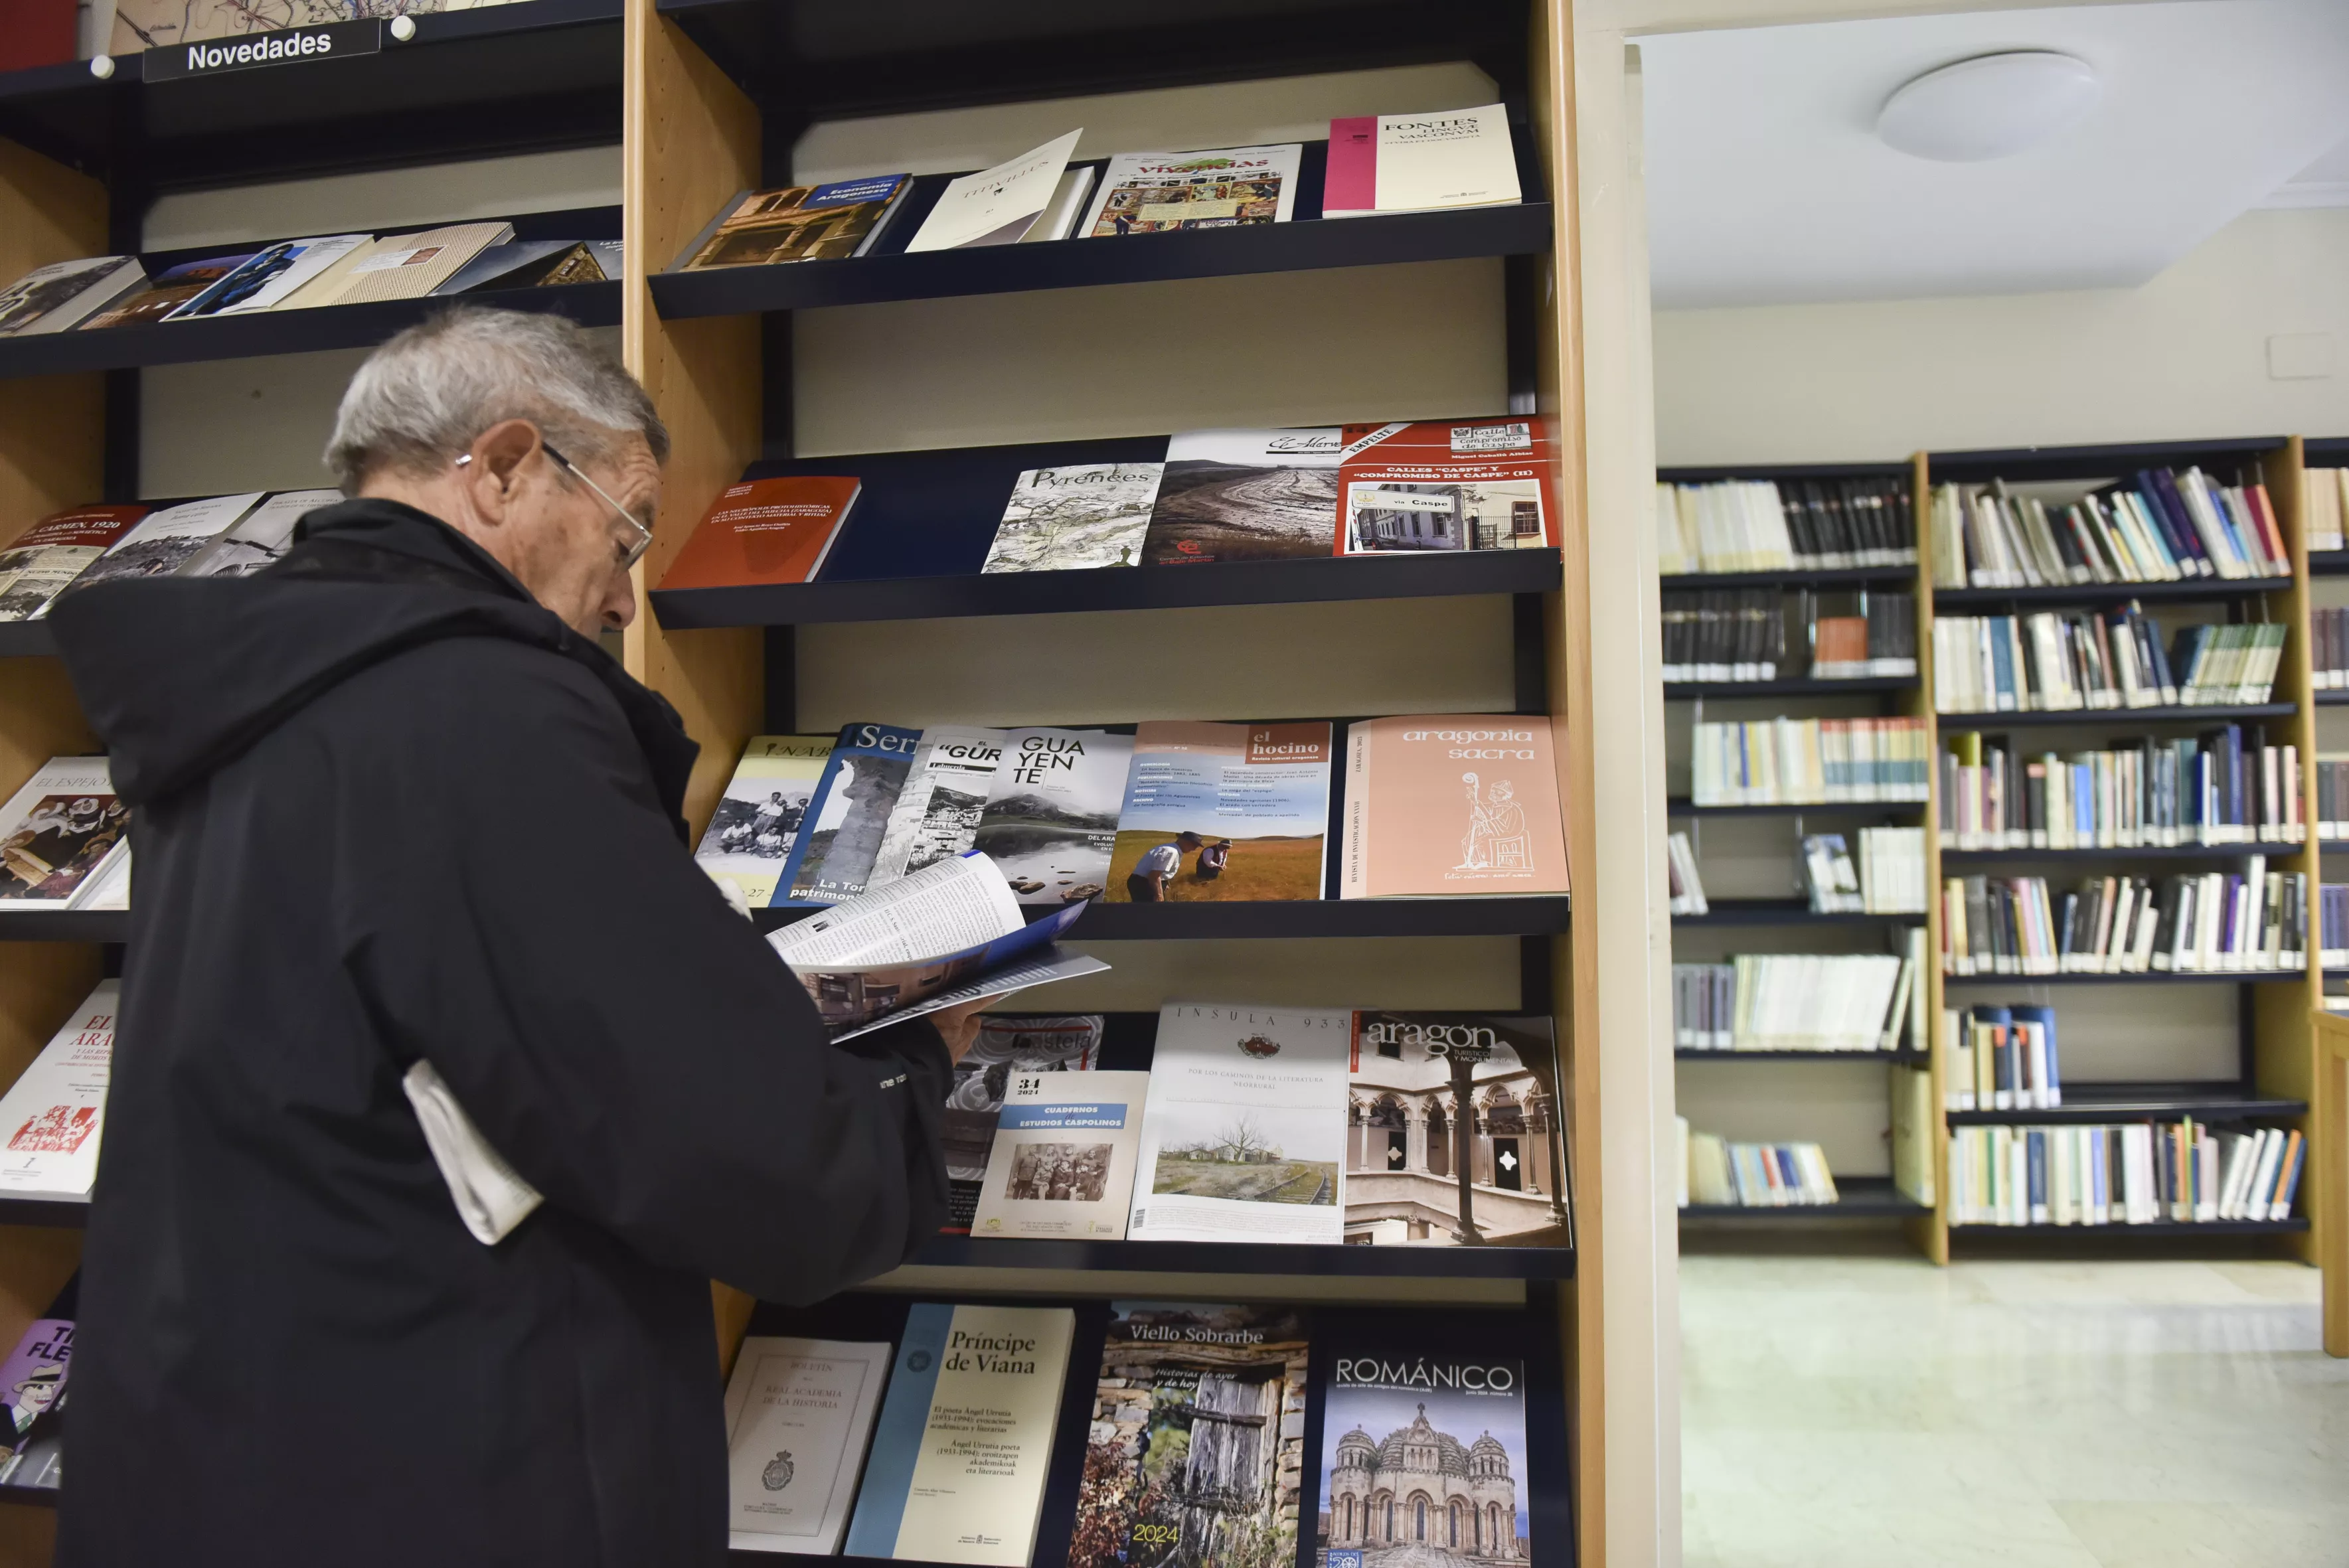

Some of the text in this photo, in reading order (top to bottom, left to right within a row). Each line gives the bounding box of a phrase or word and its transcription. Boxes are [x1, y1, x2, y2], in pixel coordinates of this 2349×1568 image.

[188, 31, 331, 69] Novedades
[1385, 117, 1478, 131] FONTES
[1399, 129, 1479, 139] VASCONVM
[816, 188, 889, 201] Aragonesa
[829, 182, 892, 195] Economía
[1269, 436, 1342, 449] El Adarve
[1348, 428, 1394, 453] EMPELTE
[1460, 435, 1522, 444] Compromiso
[1031, 471, 1149, 489] Pyrénées
[730, 505, 769, 514] NECRÓPOLIS
[1412, 499, 1448, 508] Caspe
[38, 521, 88, 533] CARMEN,
[1254, 731, 1270, 742] el
[1403, 729, 1533, 744] aragonia
[1021, 736, 1086, 756] GUA
[1252, 742, 1319, 755] hocino
[1448, 748, 1535, 759] sacra
[1018, 752, 1074, 771] YEN
[1013, 768, 1043, 784] TE
[35, 777, 107, 789] EL ESPEJO
[819, 878, 837, 889] La
[748, 888, 765, 898] 27
[83, 1015, 114, 1030] EL
[1176, 1007, 1346, 1029] INSULA 933
[1366, 1022, 1500, 1056] aragón
[1220, 1070, 1254, 1079] CAMINOS
[1279, 1075, 1324, 1083] LITERATURA
[1018, 1078, 1040, 1089] 34
[1233, 1081, 1277, 1090] NEORRURAL
[1131, 1324, 1264, 1344] Viello Sobrarbe
[950, 1330, 1036, 1357] Príncipe
[26, 1342, 72, 1362] FLE
[790, 1362, 833, 1372] BOLETÍN
[945, 1352, 1036, 1375] de Viana
[1155, 1368, 1238, 1383] Historias de ayer
[1336, 1358, 1513, 1391] ROMÁNICO
[1156, 1377, 1199, 1392] y de hoy
[765, 1385, 842, 1398] REAL ACADEMIA
[763, 1396, 838, 1409] DE LA HISTORIA
[965, 1406, 985, 1417] Ángel
[932, 1413, 975, 1425] (1933-1994):
[930, 1422, 969, 1431] académicas
[951, 1439, 1021, 1452] Ángel Urrutia poeta
[936, 1447, 1019, 1460] (1933-1994): oroitzapen
[969, 1458, 1017, 1468] akademikoak
[978, 1468, 1016, 1476] literarioak
[1133, 1524, 1178, 1543] 2024
